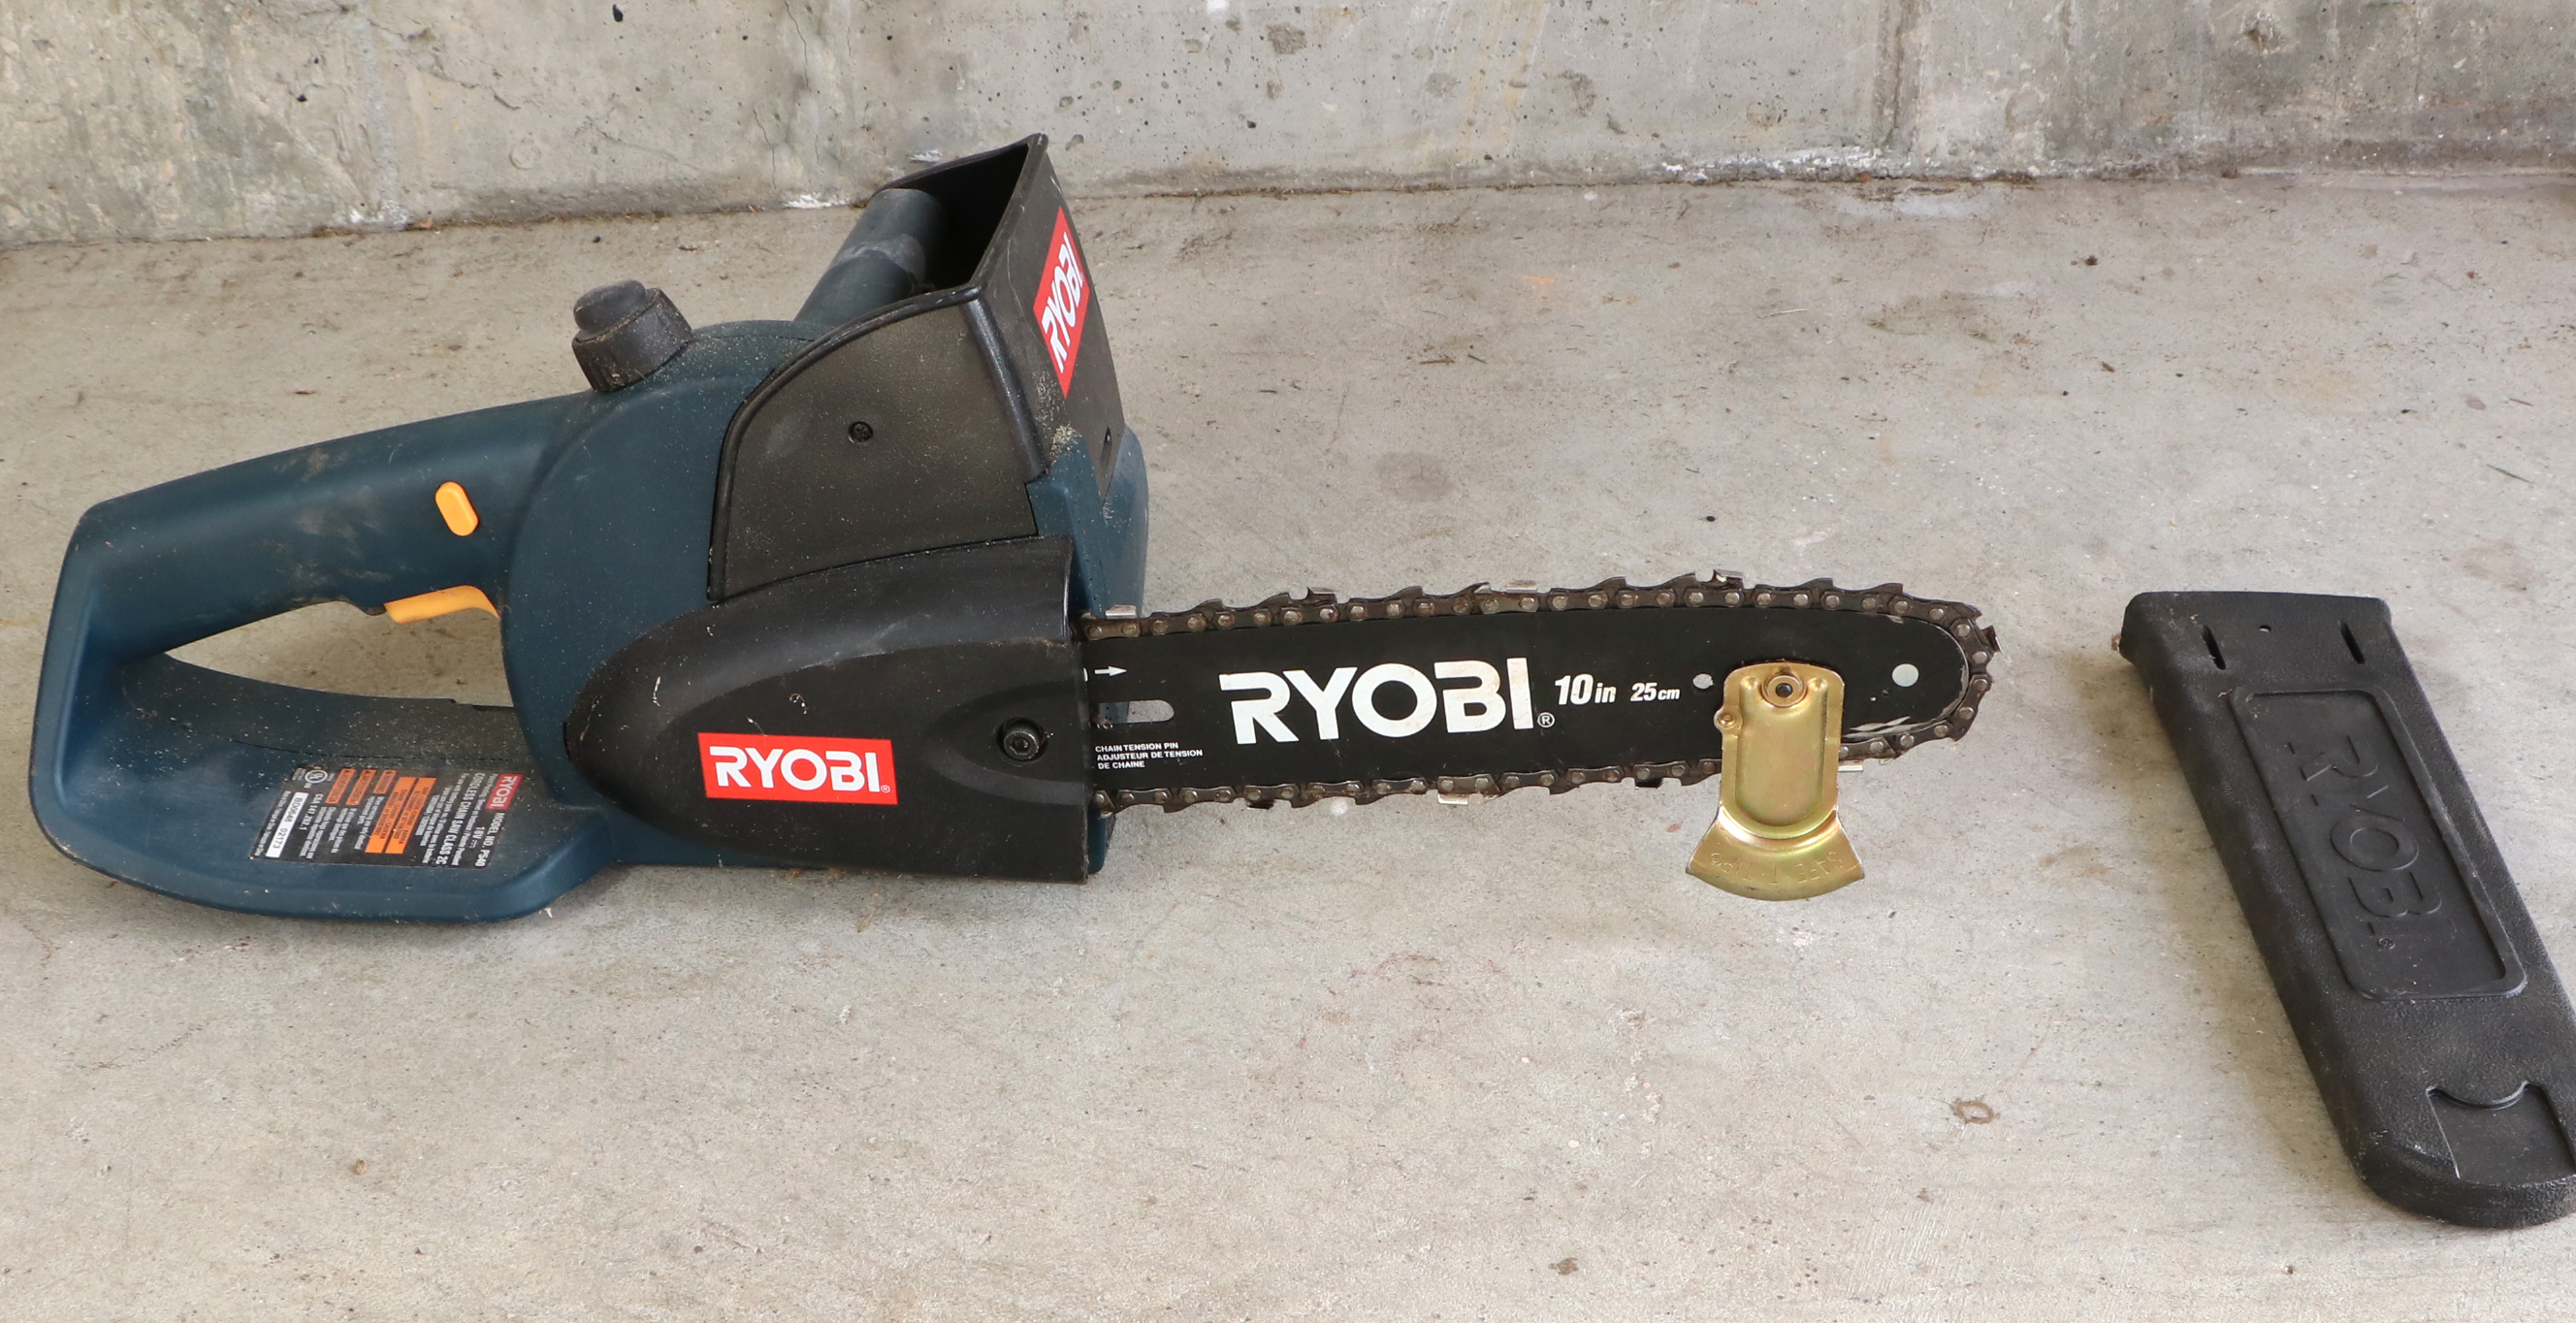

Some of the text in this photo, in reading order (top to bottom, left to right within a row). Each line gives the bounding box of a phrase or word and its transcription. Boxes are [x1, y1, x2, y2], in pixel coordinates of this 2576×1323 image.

[1041, 231, 1084, 373] RYOBI
[1218, 657, 1534, 745] RYOBI
[1097, 752, 1148, 761] ADJUSTEUR
[1123, 743, 1162, 752] TENSION
[709, 746, 881, 792] RYOBI
[1112, 760, 1145, 769] CHAINE
[462, 772, 485, 800] CORDLESS
[489, 775, 518, 807] RYOBI
[453, 800, 471, 819] CHAIN
[447, 820, 464, 833] SAW
[471, 825, 486, 839] 18V
[486, 812, 504, 834] MODEL
[271, 827, 289, 849] 02173
[437, 833, 457, 855] CLASS
[434, 855, 448, 864] 2C
[473, 849, 490, 866] P540
